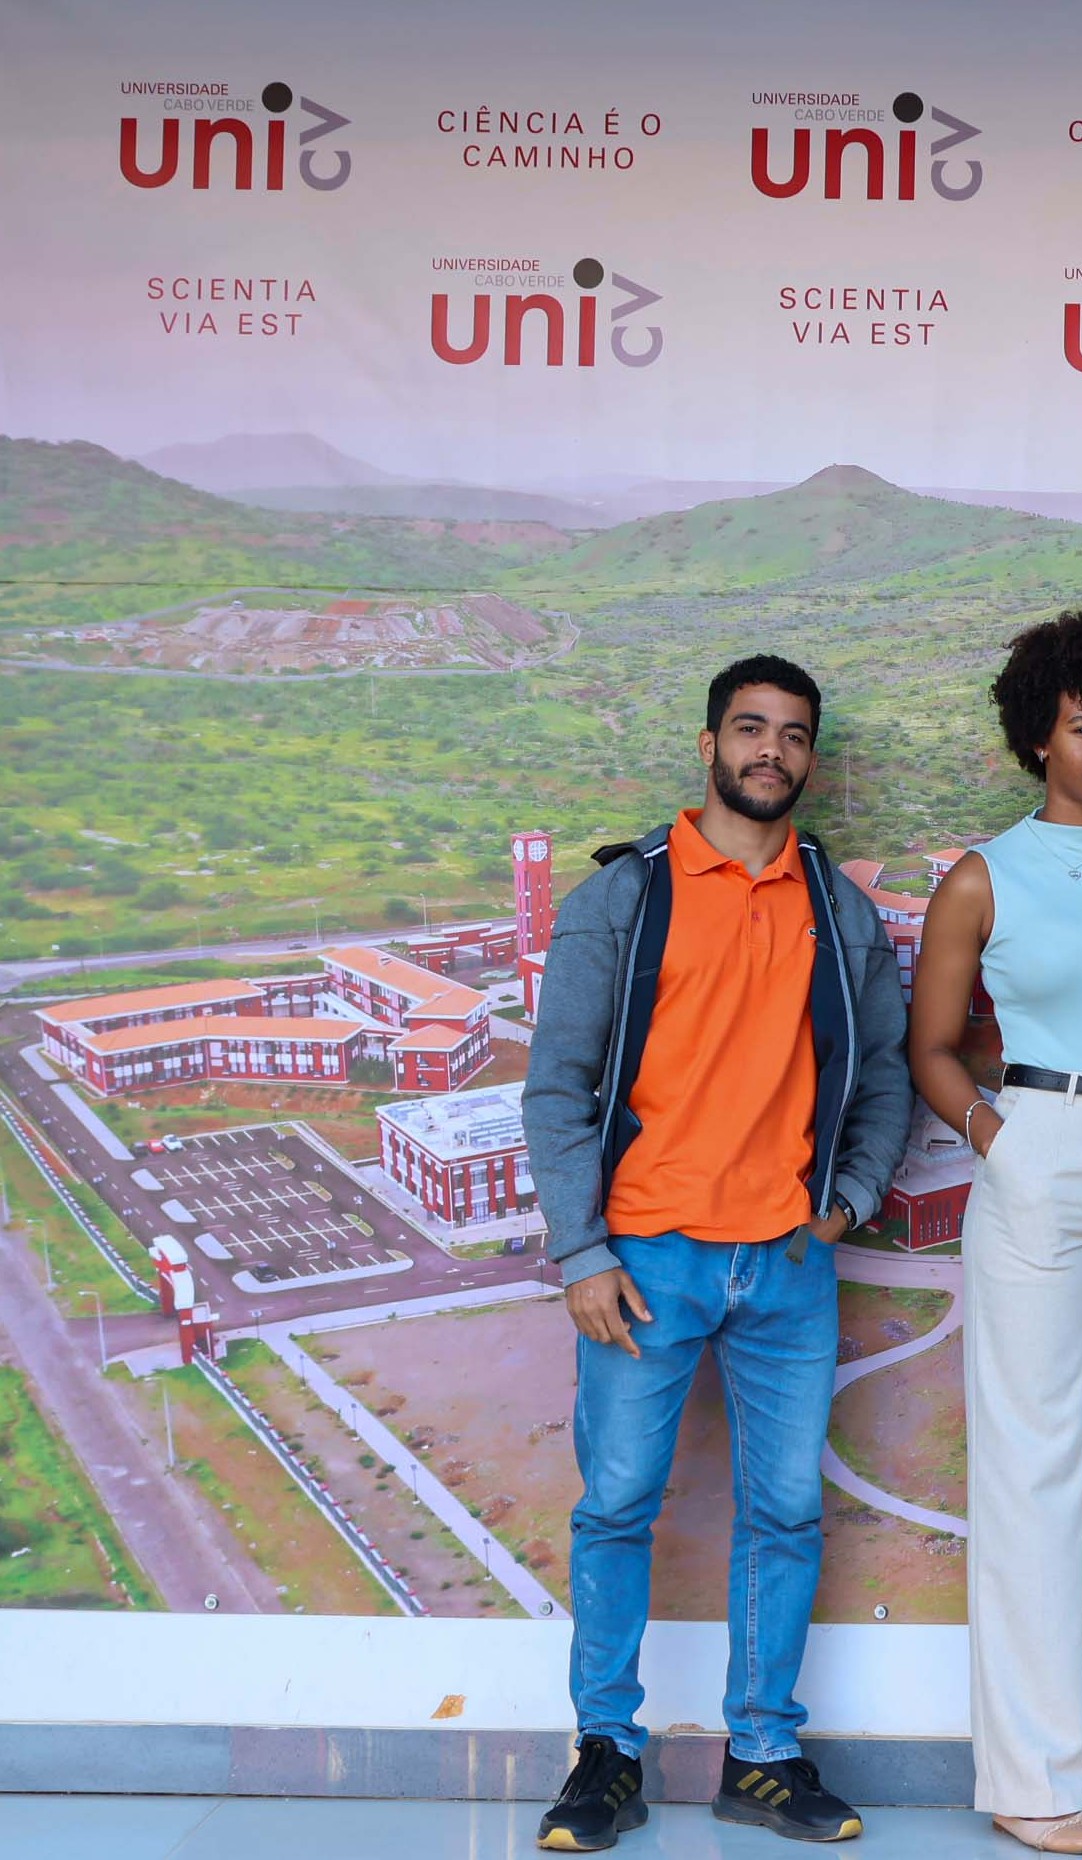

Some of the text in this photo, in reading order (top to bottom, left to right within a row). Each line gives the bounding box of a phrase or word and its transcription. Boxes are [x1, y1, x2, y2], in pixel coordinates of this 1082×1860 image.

[121, 82, 228, 95] UNIVERSIDADE
[163, 98, 255, 112] CABO VERDE
[752, 92, 860, 105] UNIVERSIDADE
[438, 105, 660, 136] CIÊNCIA É O
[794, 108, 885, 122] CABO VERDE
[464, 144, 635, 170] CAMINHO
[432, 258, 540, 271] UNIVERSIDADE
[147, 278, 315, 301] SCIENTIA
[474, 274, 565, 287] CABO VERDE
[780, 287, 948, 311] SCIENTIA
[160, 312, 301, 335] VIA EST
[793, 322, 934, 345] VIA EST
